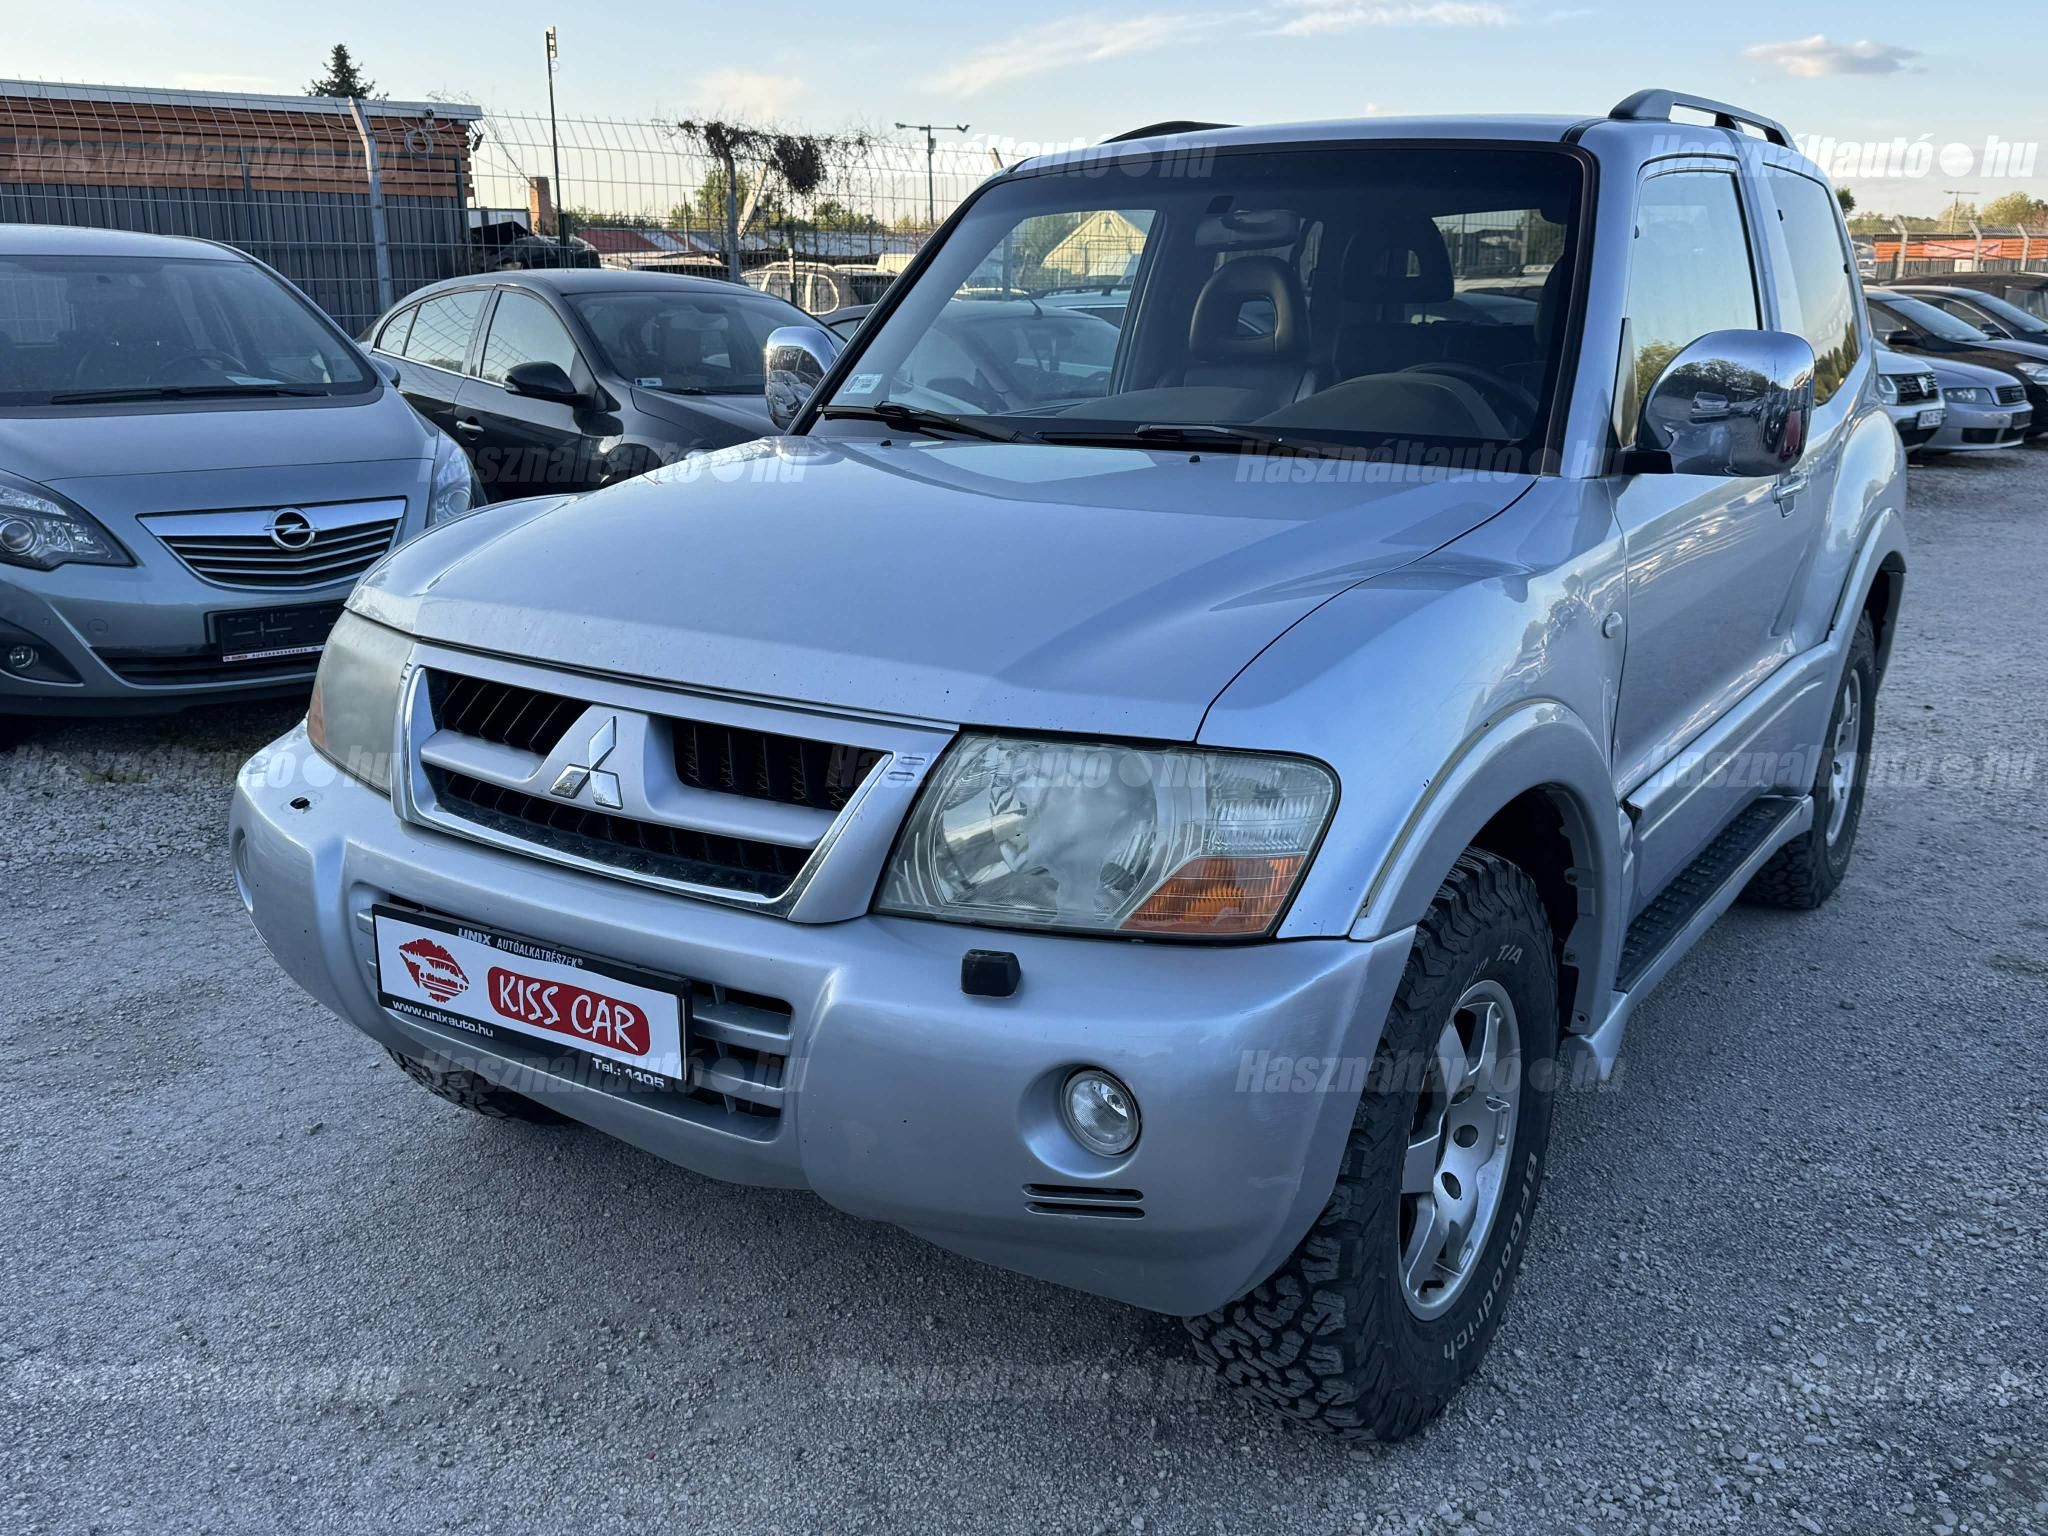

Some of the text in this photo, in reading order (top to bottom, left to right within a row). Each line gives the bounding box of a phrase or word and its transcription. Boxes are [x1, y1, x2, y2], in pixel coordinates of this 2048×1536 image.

[458, 927, 492, 946] UNIX
[1496, 944, 1523, 965] T/A
[392, 1000, 494, 1038] www.unixauto.hu
[499, 974, 639, 1052] KISS CAR
[592, 1057, 665, 1088] Tel.: 1405
[1444, 1152, 1538, 1361] BFGoodrich
